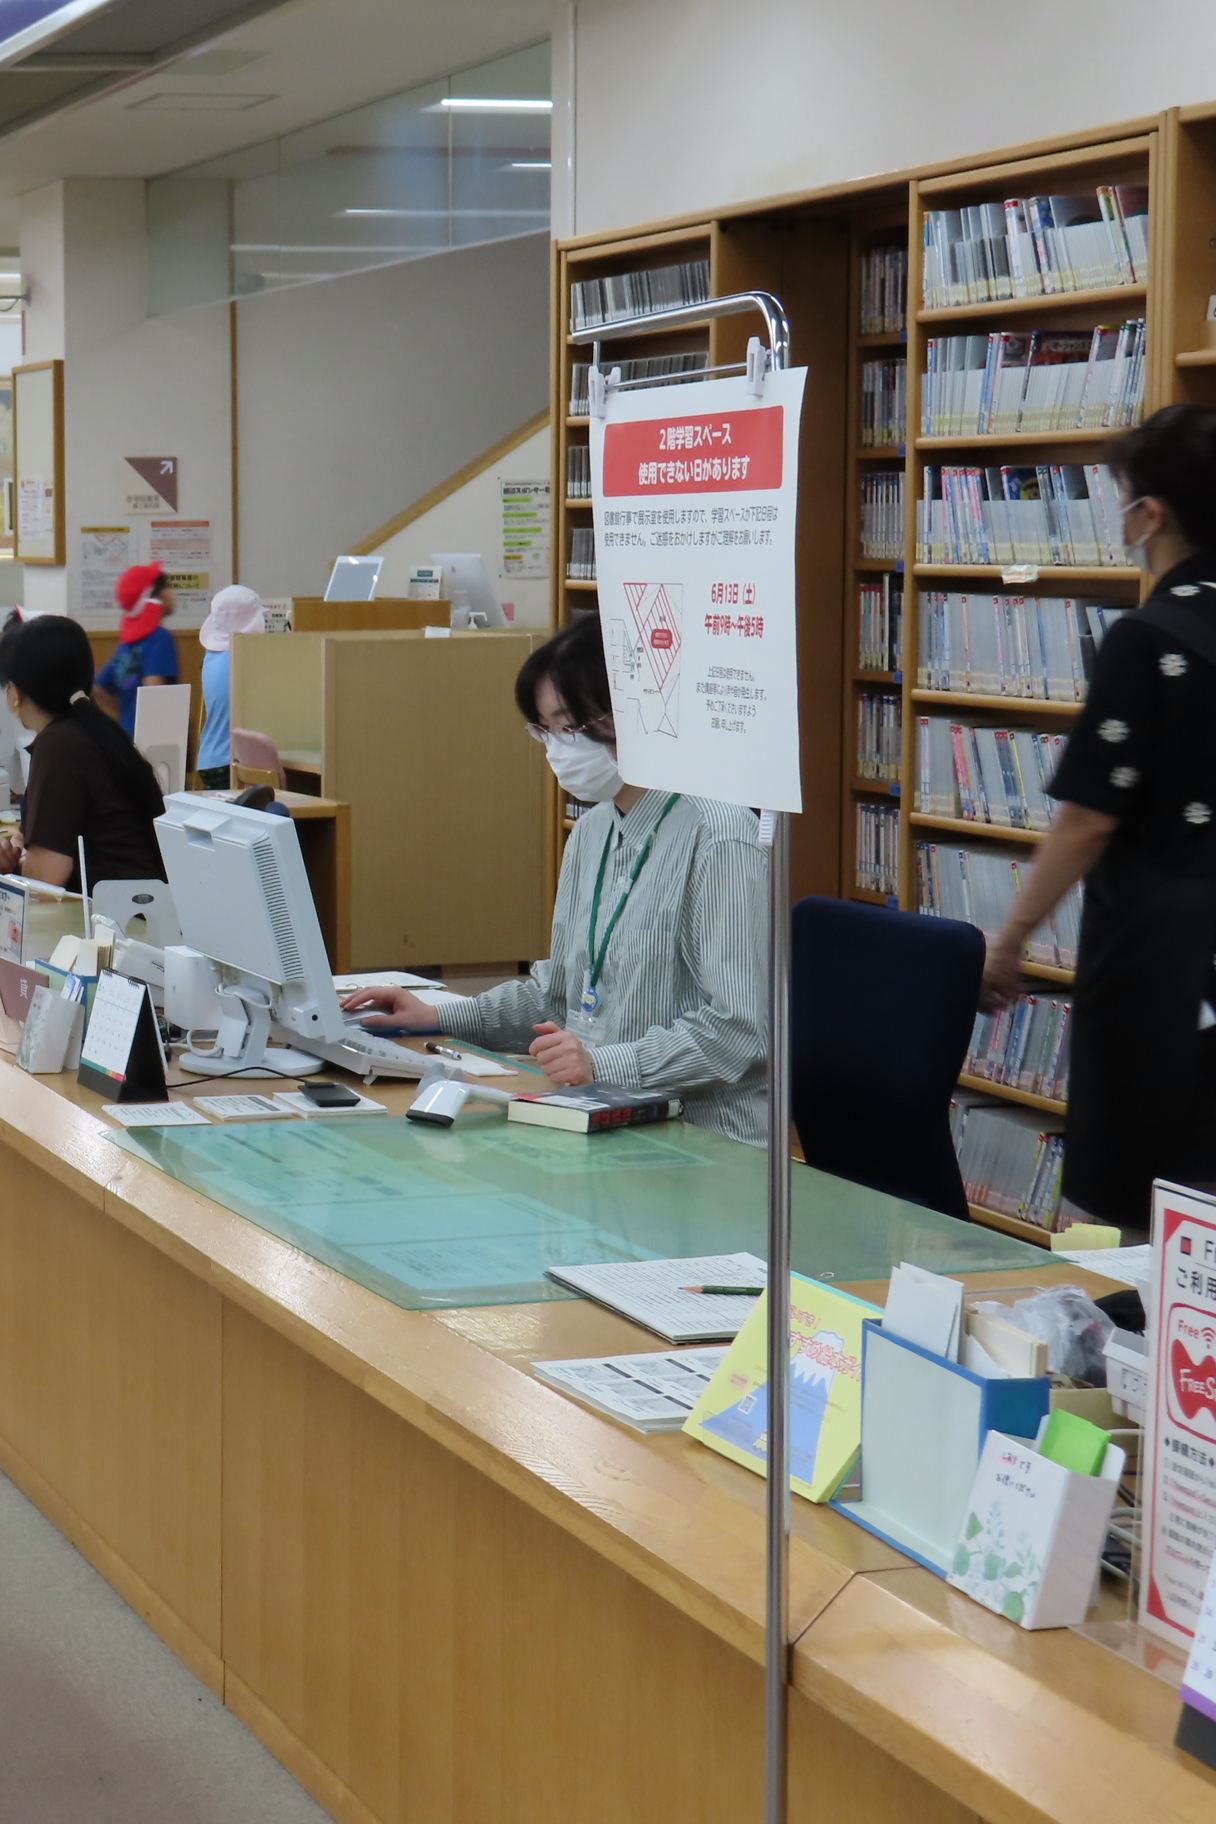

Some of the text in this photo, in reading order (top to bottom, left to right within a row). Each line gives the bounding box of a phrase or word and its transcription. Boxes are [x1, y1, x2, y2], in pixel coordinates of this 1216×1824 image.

[659, 423, 732, 450] 2階学習スペース
[638, 455, 751, 486] 使用できない日があります
[1178, 1319, 1200, 1340] Free
